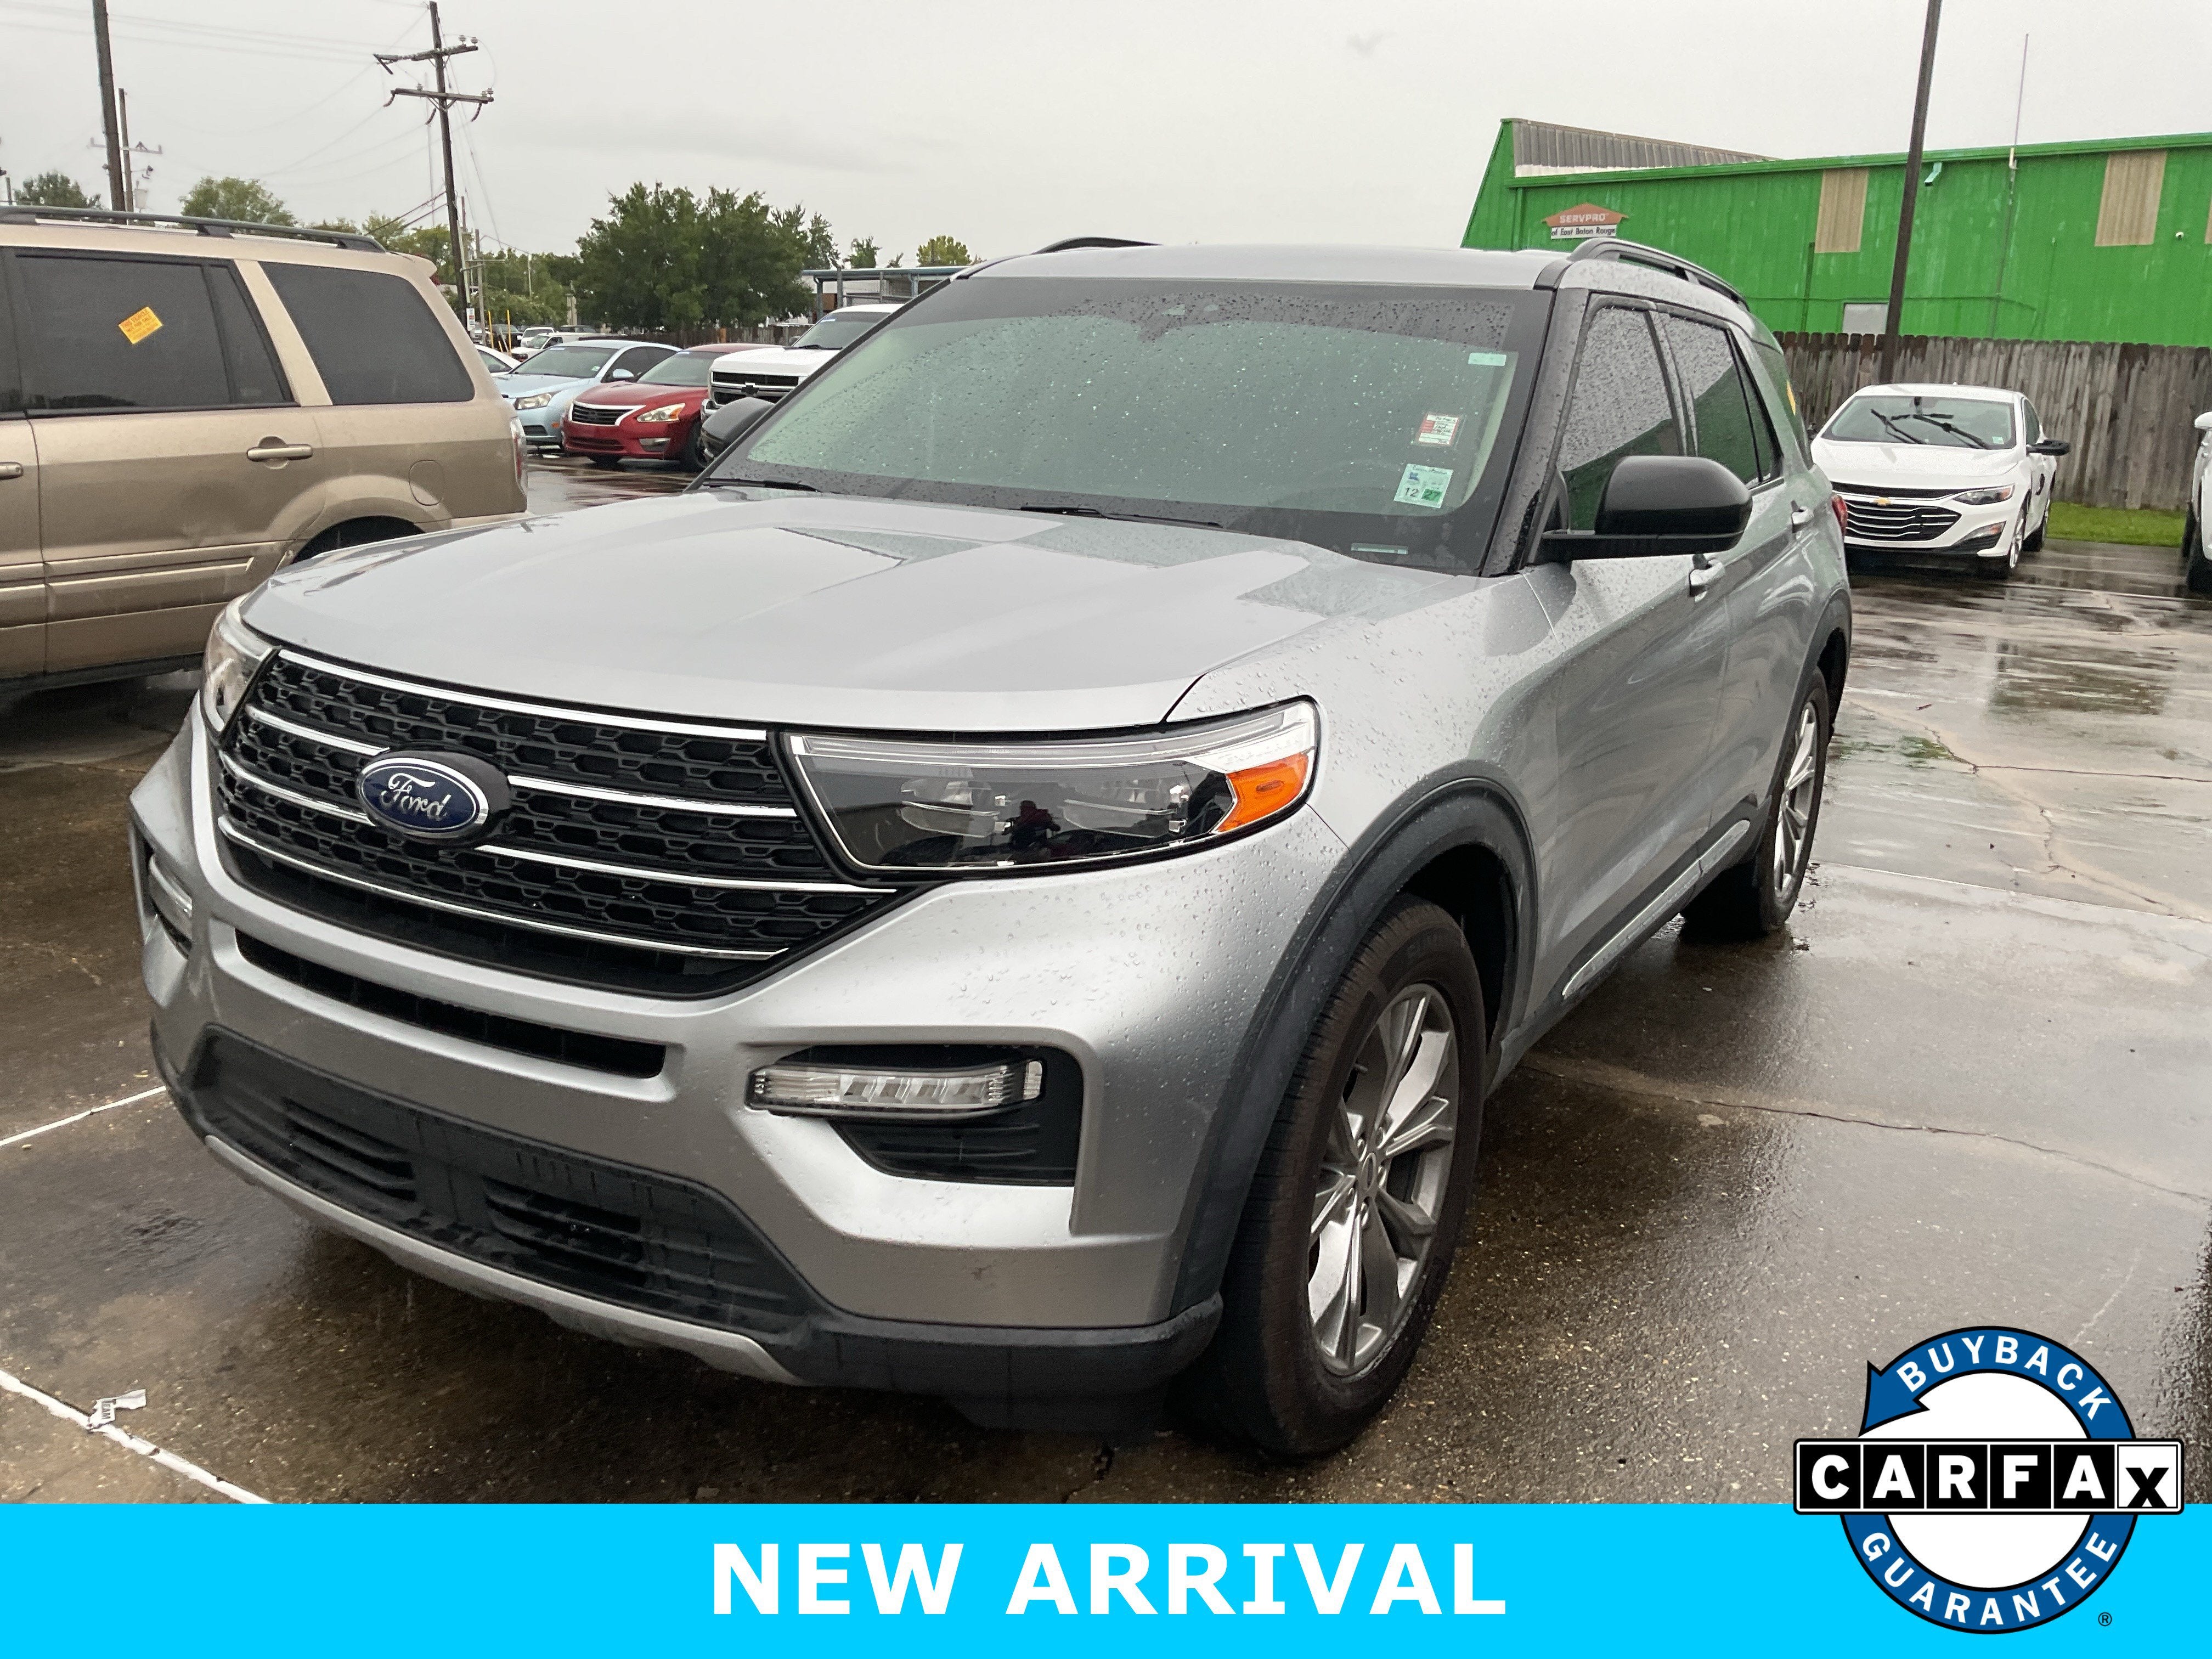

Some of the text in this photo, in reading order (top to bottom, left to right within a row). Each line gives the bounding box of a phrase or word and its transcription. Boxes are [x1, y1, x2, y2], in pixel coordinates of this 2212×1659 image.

[1560, 213, 1606, 223] SERVPRO
[1576, 227, 1593, 235] Baton
[1596, 226, 1616, 235] Rouge
[1404, 487, 1419, 497] 12
[380, 772, 452, 821] Ford
